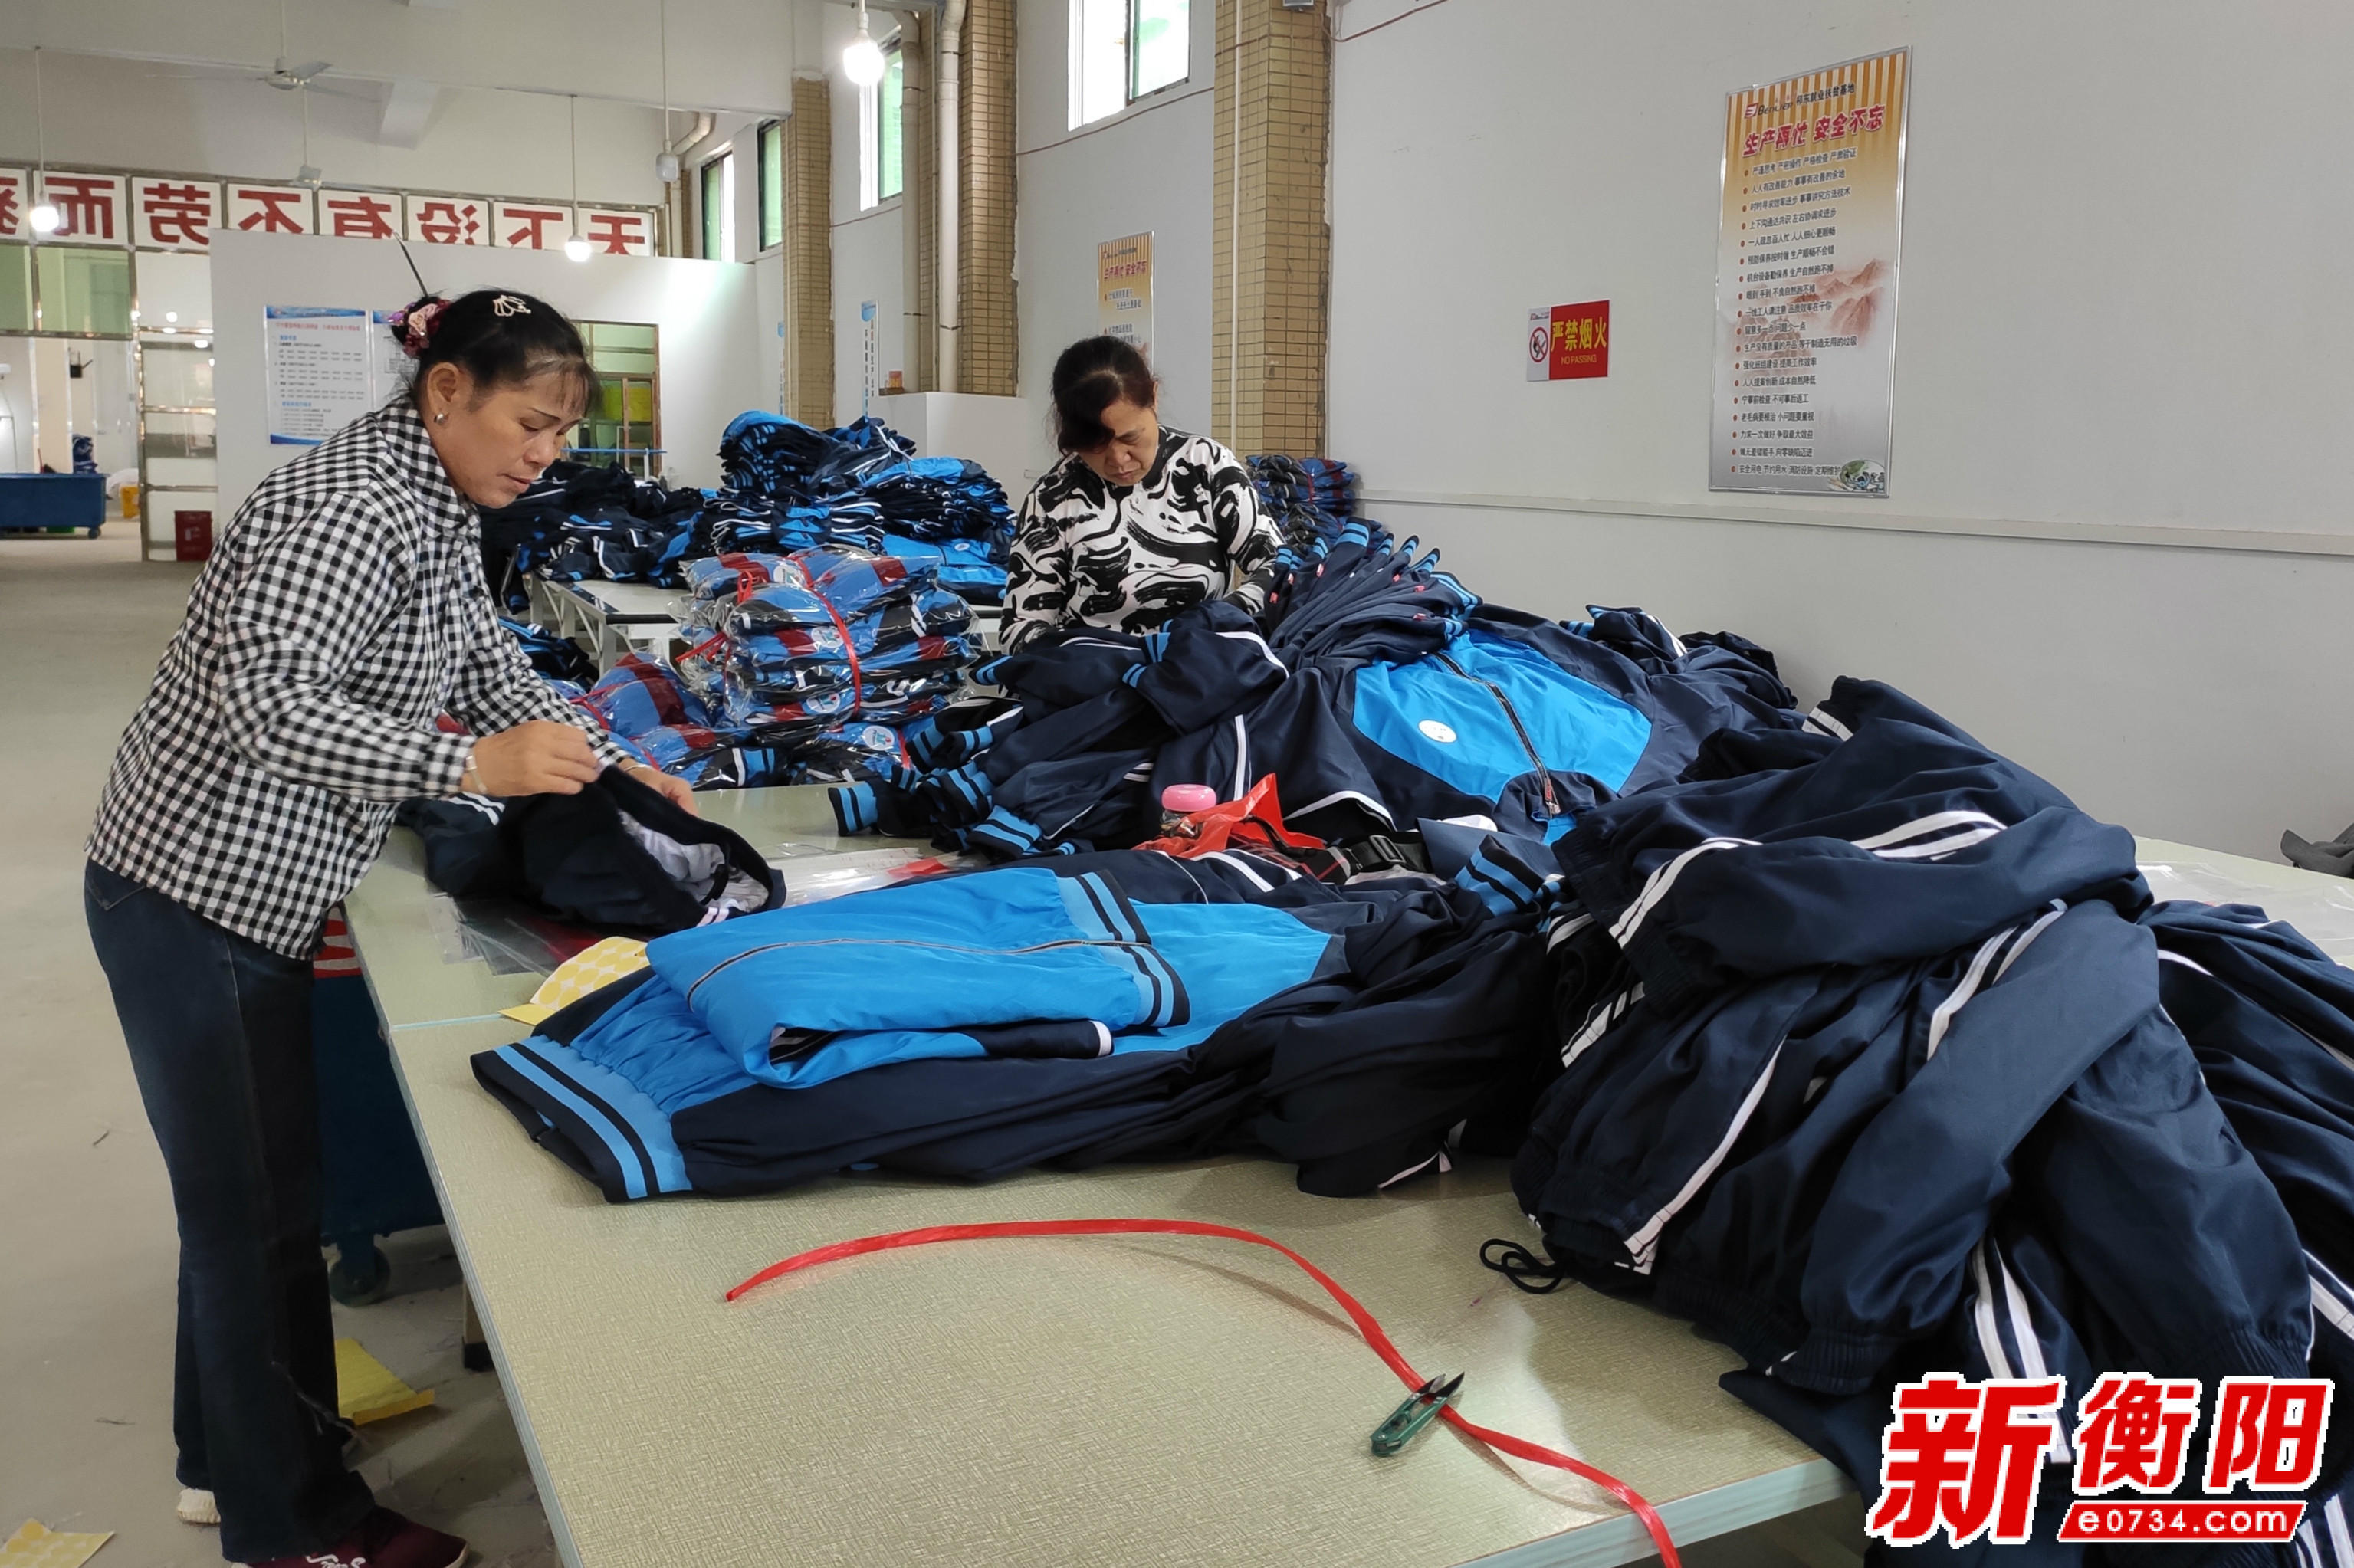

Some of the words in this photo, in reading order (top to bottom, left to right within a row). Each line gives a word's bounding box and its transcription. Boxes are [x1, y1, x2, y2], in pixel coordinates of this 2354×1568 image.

[1742, 120, 1809, 157] 生产再忙
[1812, 104, 1886, 143] 安全不忘
[1551, 316, 1607, 353] 严禁烟火
[1561, 356, 1571, 365] NO
[1571, 354, 1597, 364] PASSING
[1779, 357, 1817, 368] 提高工作效率
[1778, 375, 1817, 385] 成本自然降低
[1739, 464, 1761, 474] 安全用电
[1764, 464, 1787, 474] 节约用水
